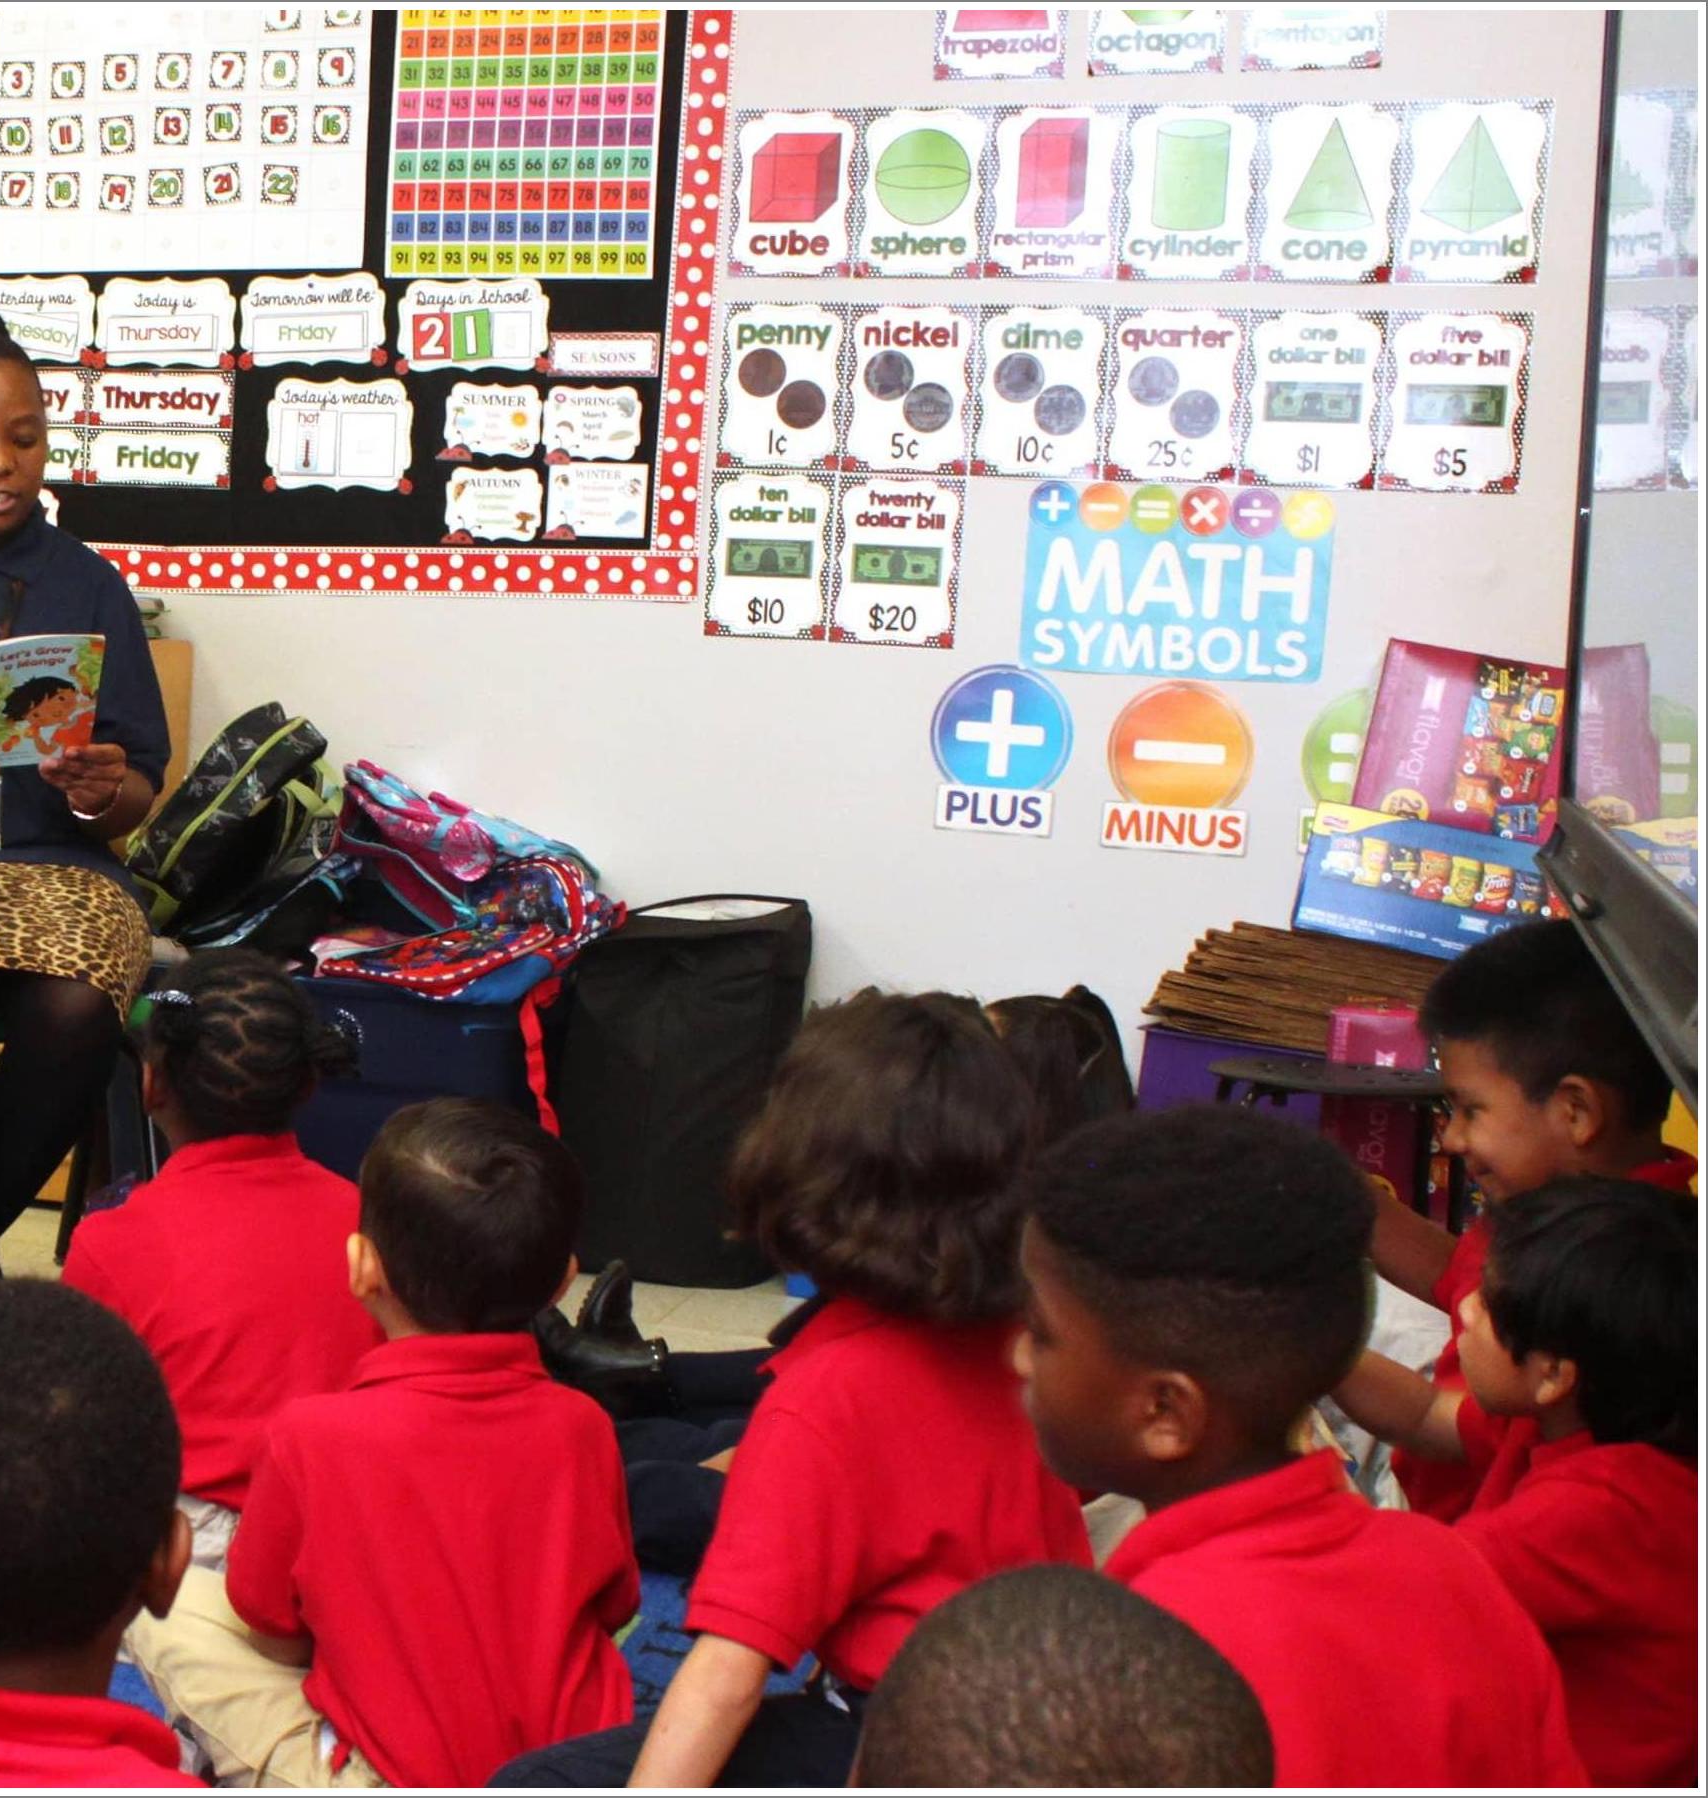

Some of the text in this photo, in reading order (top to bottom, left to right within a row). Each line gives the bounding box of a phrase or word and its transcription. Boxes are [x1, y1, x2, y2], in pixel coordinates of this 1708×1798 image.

[942, 33, 1057, 58] trapezoid
[1097, 27, 1216, 57] octagon
[1251, 20, 1375, 50] pentagon
[108, 172, 293, 203] 19 20 21 22
[749, 230, 830, 256] cube
[870, 231, 967, 259] sphere
[994, 231, 1106, 249] rectangular
[1129, 233, 1242, 262] cylinder
[1281, 234, 1368, 262] cone
[1408, 232, 1528, 262] pyramid
[600, 252, 646, 265] 99 100
[1022, 252, 1074, 270] prism
[134, 294, 178, 314] Today
[251, 290, 352, 307] Tomorrow will
[415, 290, 475, 311] Days in
[118, 324, 201, 342] Thursday
[278, 324, 337, 344] Friday
[736, 321, 832, 351] penny
[863, 320, 959, 348] nickel
[1001, 321, 1084, 349] dime
[1121, 324, 1234, 353] quarter
[1299, 324, 1338, 343] one
[1440, 326, 1483, 344] five
[571, 352, 636, 363] SEASONS
[1268, 346, 1366, 366] dollar bill
[1409, 349, 1511, 368] dollar bill
[103, 385, 220, 416] Thursday
[281, 390, 339, 409] Today's
[463, 394, 527, 407] SUMMER
[570, 396, 617, 406] SPRING
[297, 411, 320, 425] hot
[768, 429, 787, 455] 1¢
[891, 433, 919, 459] 5¢
[1017, 436, 1054, 463] 10¢
[116, 445, 200, 474] Friday
[1297, 445, 1320, 472] $1
[1432, 448, 1467, 477] $5
[469, 478, 521, 488] AUTUMN
[575, 469, 622, 480] WINTER
[758, 484, 789, 502] ten
[869, 489, 935, 511] twenty
[729, 503, 816, 523] dollar bill
[856, 511, 945, 530] dollar bill
[1036, 536, 1313, 625] MATH
[747, 597, 785, 624] $10
[869, 602, 916, 632] $20
[0, 645, 74, 663] Let's Grow
[1032, 619, 1309, 678] SYMBOLS
[17, 657, 66, 669] Mango
[1406, 713, 1441, 785] flavor
[945, 790, 1043, 829] PLUS
[1104, 806, 1243, 850] MINUS
